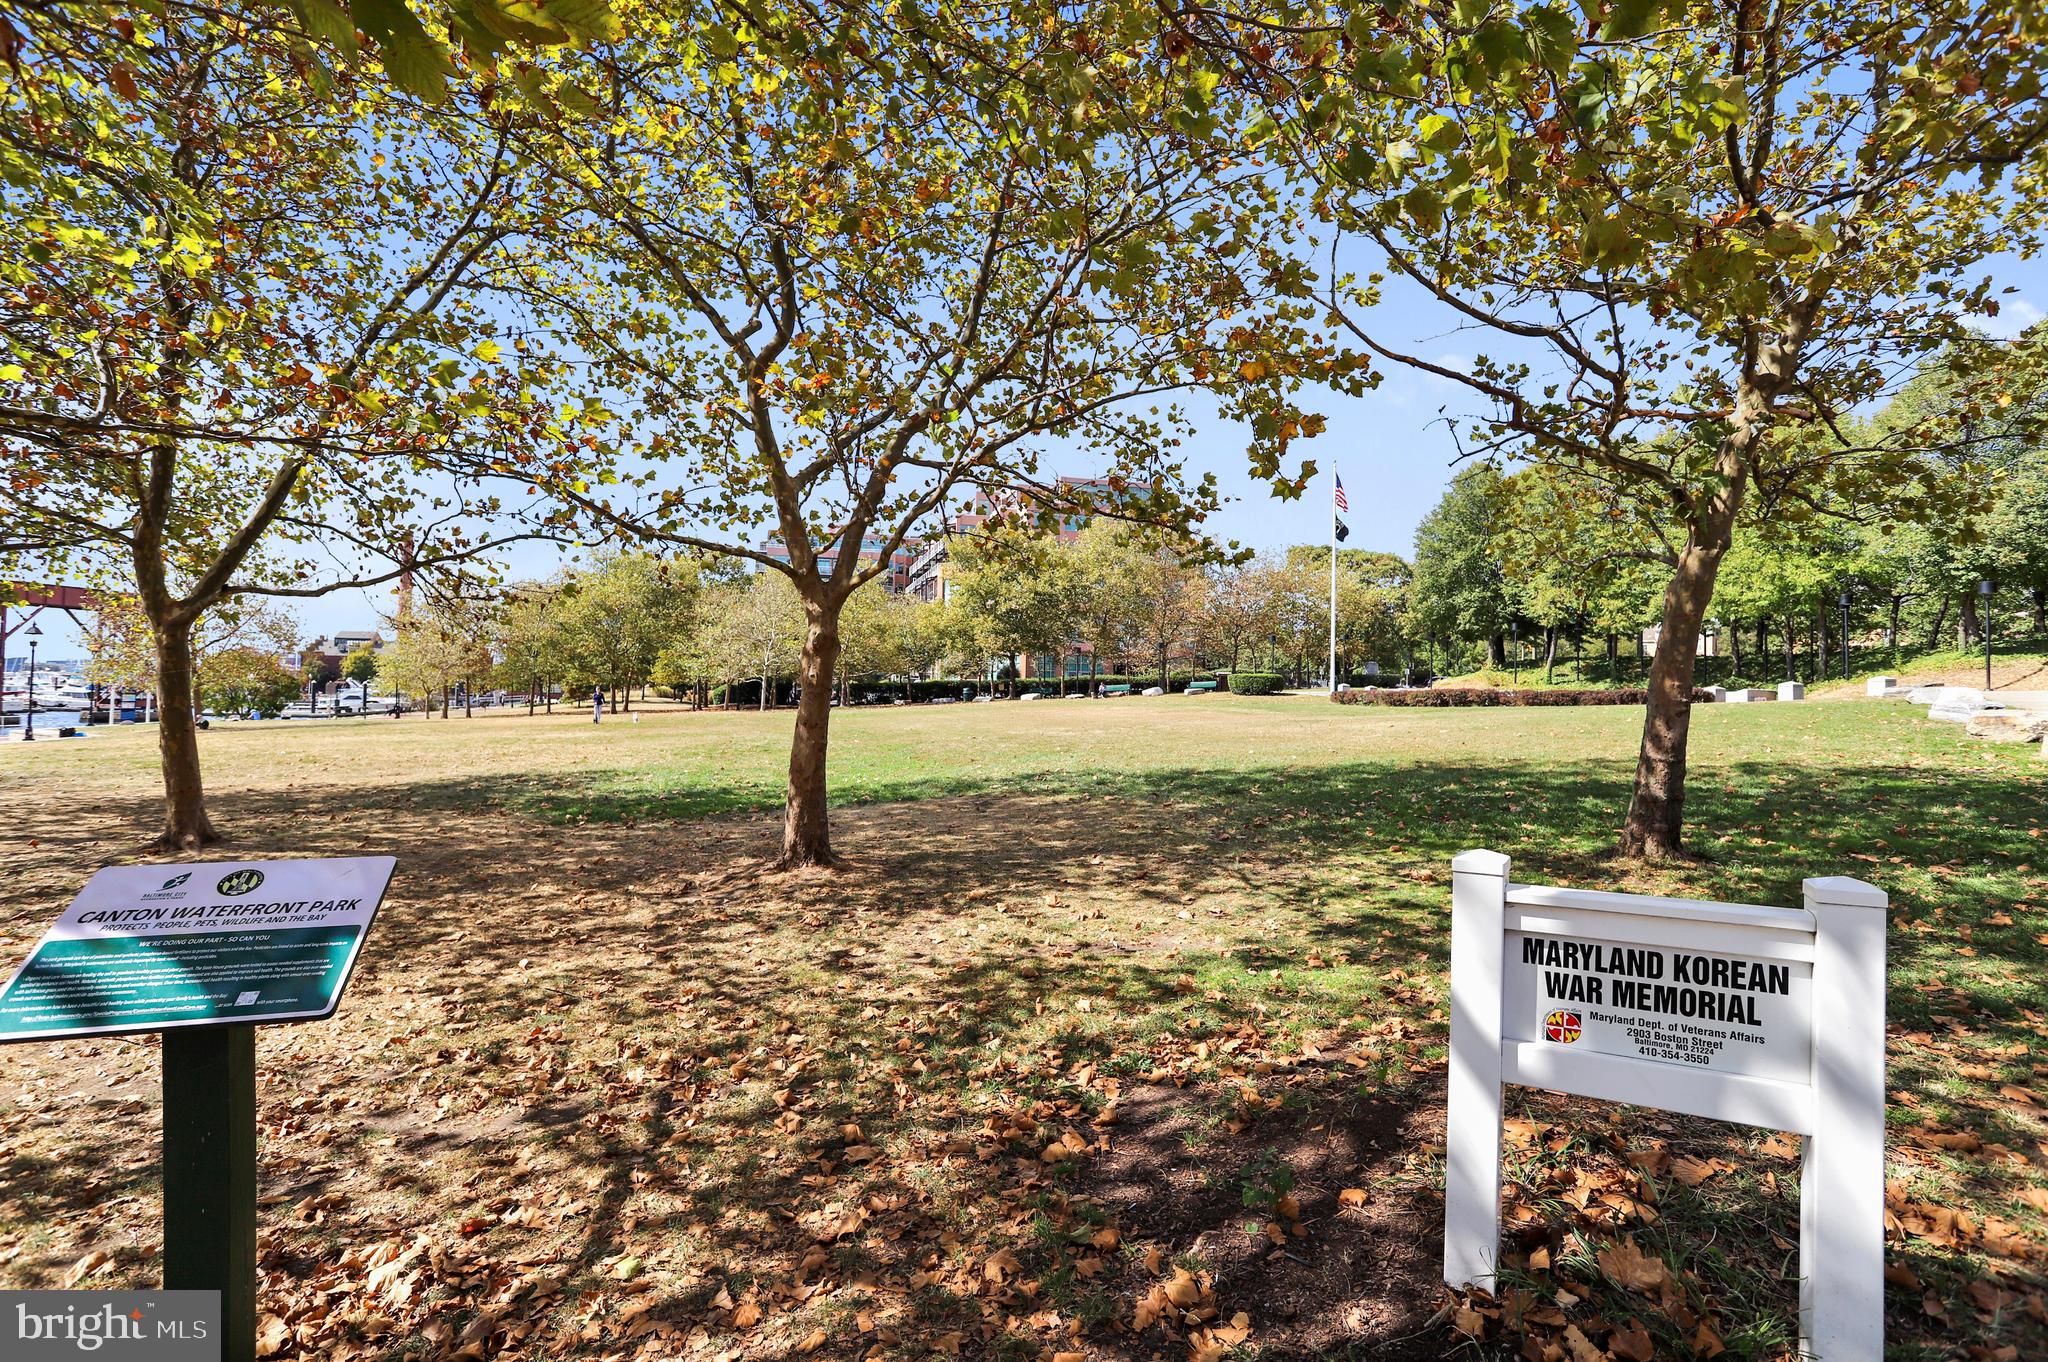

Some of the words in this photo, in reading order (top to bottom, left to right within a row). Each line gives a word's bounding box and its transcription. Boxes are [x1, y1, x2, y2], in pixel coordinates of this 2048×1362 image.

[77, 907, 169, 924] CANTON
[170, 901, 309, 919] WATERFRONT
[308, 899, 362, 913] PARK
[99, 922, 151, 932] PROTECTS
[152, 921, 192, 930] PEOPLE,
[221, 917, 266, 926] WILDLIFE
[266, 915, 288, 923] AND
[289, 914, 308, 922] THE
[308, 913, 328, 921] BAY
[162, 939, 187, 947] DOING
[1523, 937, 1664, 979] MARYLAND
[1673, 954, 1789, 995] KOREAN
[1545, 971, 1603, 1005] WAR
[1612, 979, 1762, 1027] MEMORIAL
[1589, 1011, 1635, 1025] Maryland
[1638, 1018, 1665, 1031] Dept.
[1668, 1023, 1678, 1032] of
[1681, 1024, 1727, 1039] Veterans
[1730, 1031, 1765, 1045] Affairs
[1626, 1027, 1651, 1039] 2903
[1654, 1031, 1689, 1045] Boston
[1692, 1036, 1723, 1050] Street
[1638, 1046, 1710, 1065] 410-354-3550
[1675, 1043, 1689, 1052] MD
[1690, 1045, 1715, 1055] 21224
